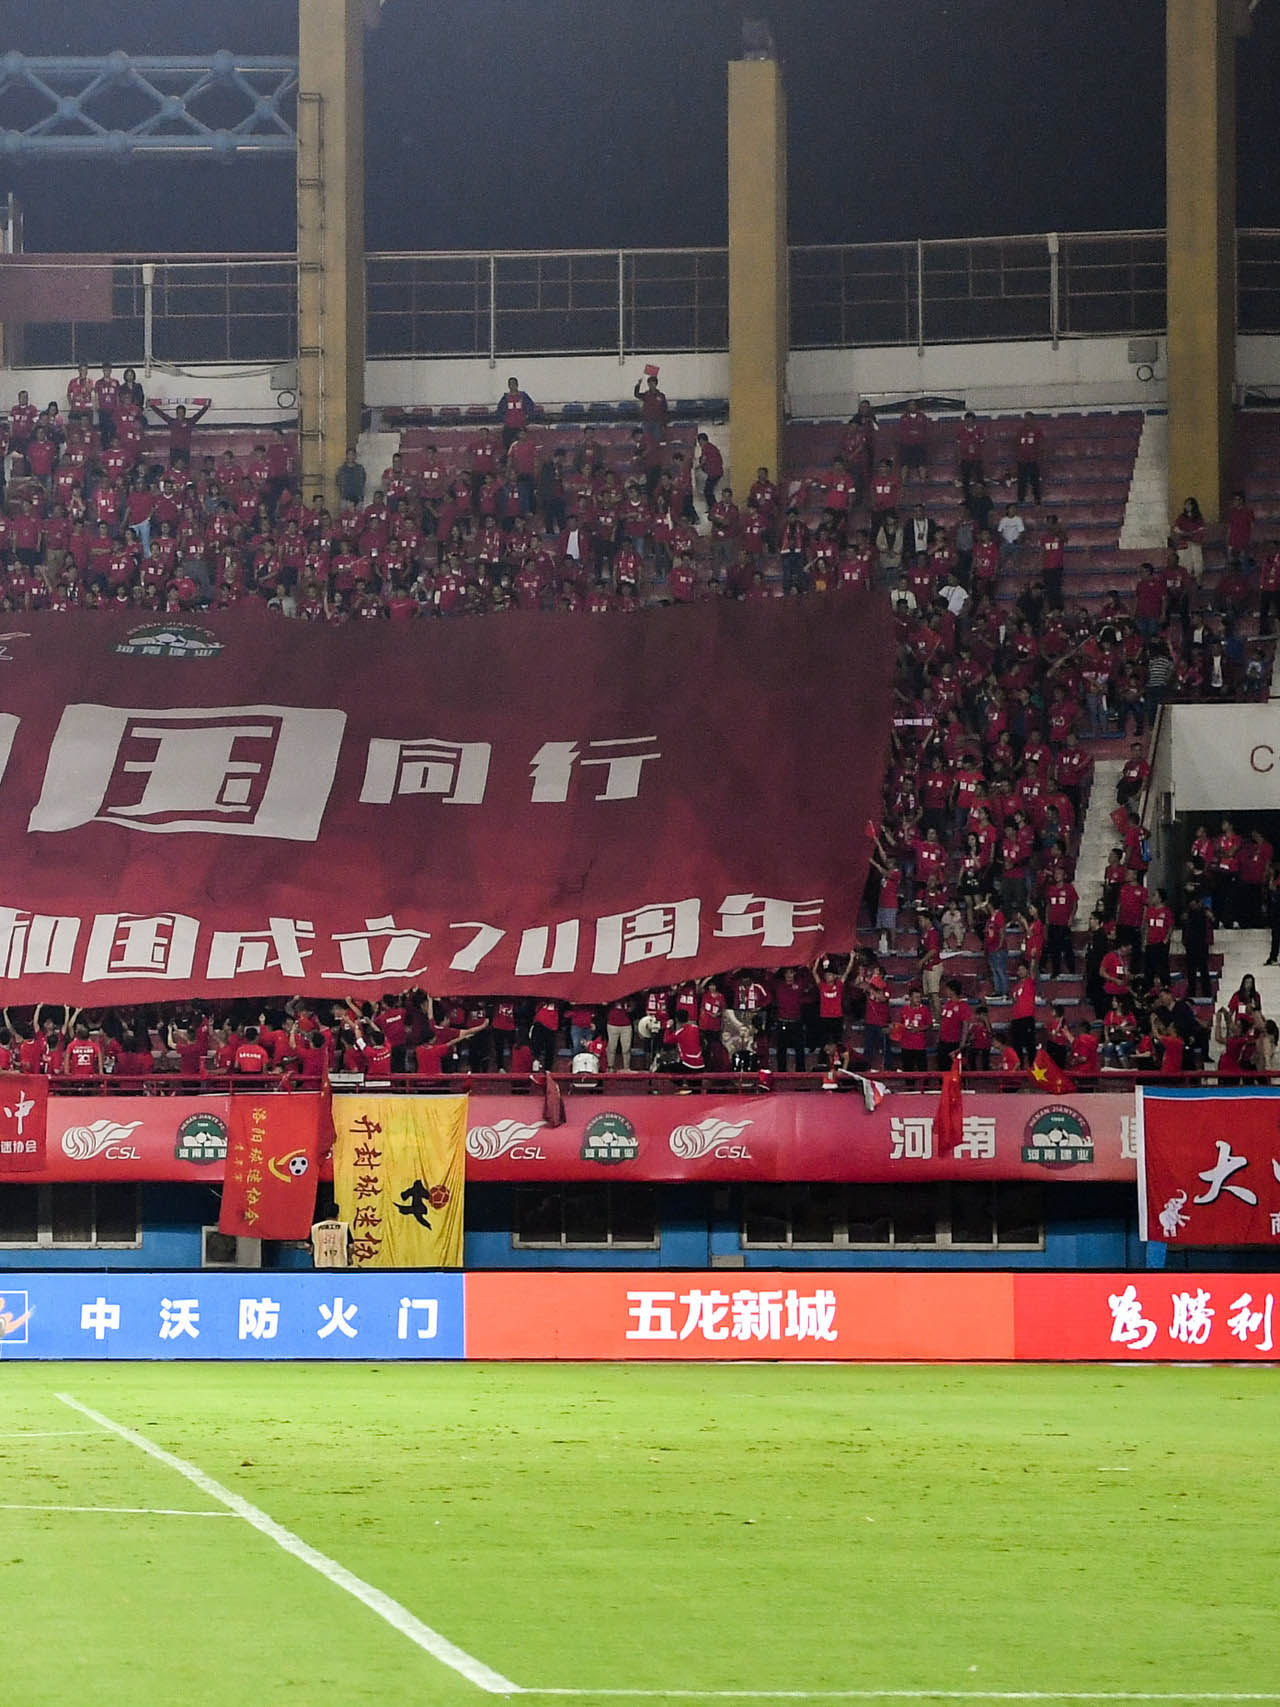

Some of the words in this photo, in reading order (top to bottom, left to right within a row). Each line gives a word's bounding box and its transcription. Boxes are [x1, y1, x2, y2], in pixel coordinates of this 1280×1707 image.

[715, 1145, 753, 1160] CSL
[889, 1115, 996, 1161] 河南
[105, 1146, 141, 1160] CSL
[509, 1146, 546, 1161] CSL
[80, 1297, 438, 1340] 中沃防火门
[625, 1289, 838, 1342] 五龙新城
